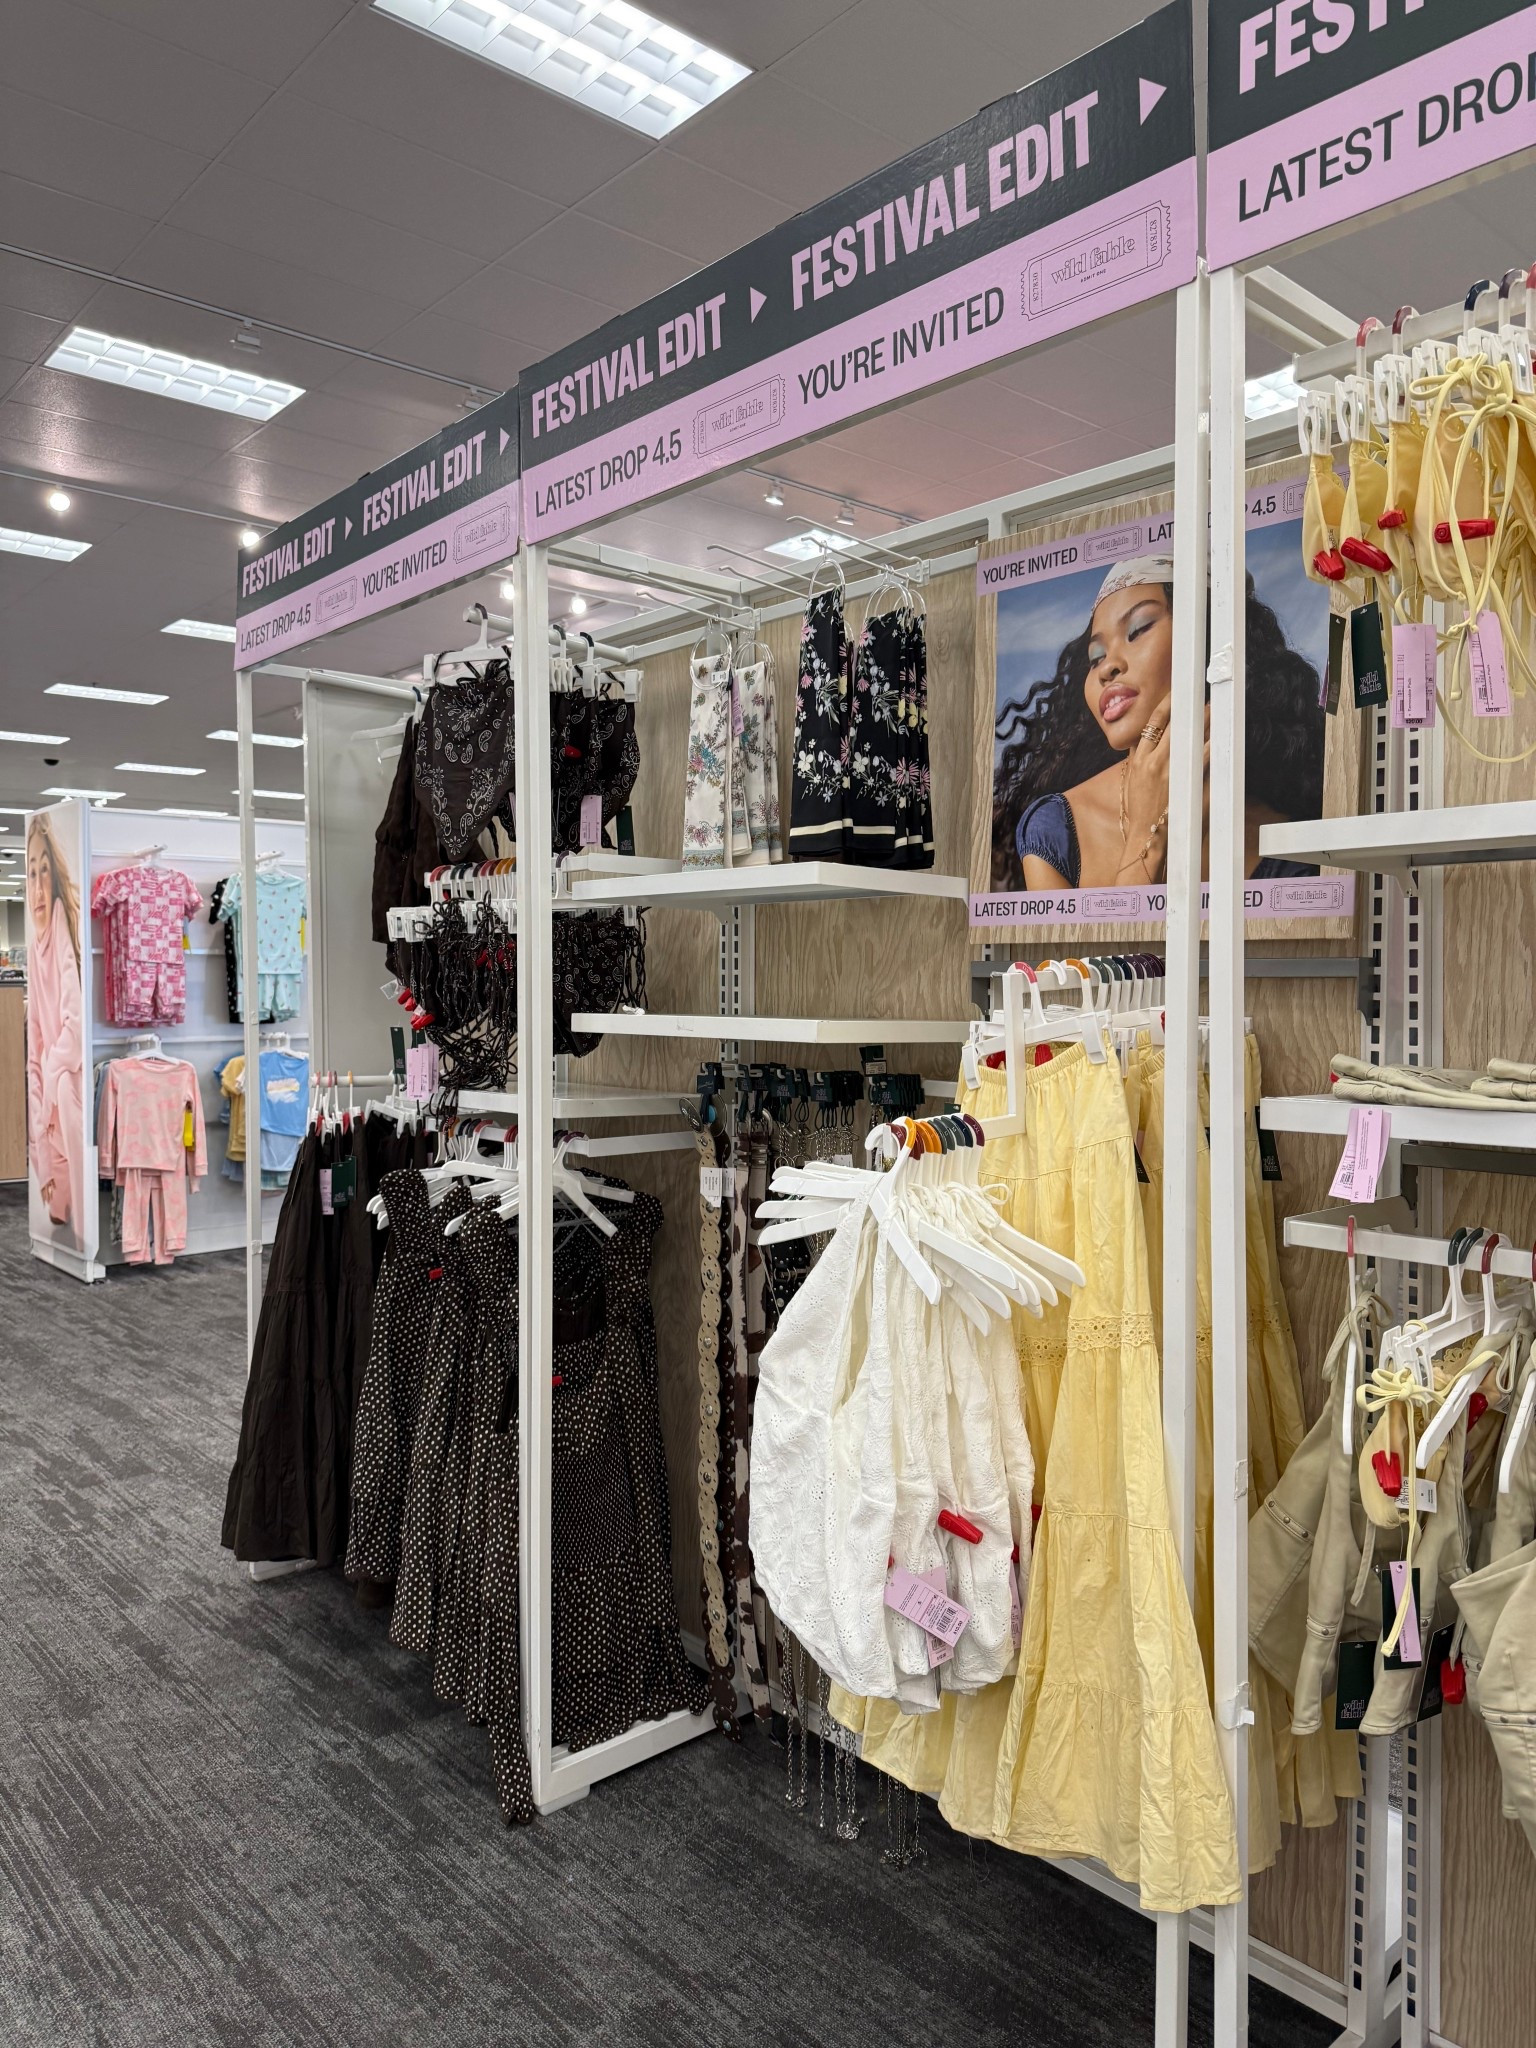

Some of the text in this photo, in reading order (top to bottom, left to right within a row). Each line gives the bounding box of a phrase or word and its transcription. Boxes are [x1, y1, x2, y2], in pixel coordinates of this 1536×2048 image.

[1239, 50, 1536, 223] LATEST DRO
[791, 89, 1099, 311] FESTIVAL EDIT
[1051, 236, 1136, 285] wild fable
[531, 292, 726, 439] FESTIVAL EDIT
[797, 286, 1005, 405] YOU'RE INVITED
[711, 408, 735, 432] wild
[735, 398, 764, 423] fable
[363, 430, 487, 537] FESTIVAL EDIT
[535, 428, 682, 518] LATEST DROP 4.5
[1251, 495, 1277, 516] 4.5
[242, 517, 336, 599] FESTIVAL EDIT
[362, 562, 400, 598] YOU'RE
[402, 539, 448, 582] INVITED
[983, 547, 1078, 585] YOU'RE INVITED
[240, 602, 312, 652] LATEST DROP 4.5
[975, 901, 1017, 918] LATEST
[1020, 900, 1054, 915] DROP
[1056, 898, 1076, 914] 4.5
